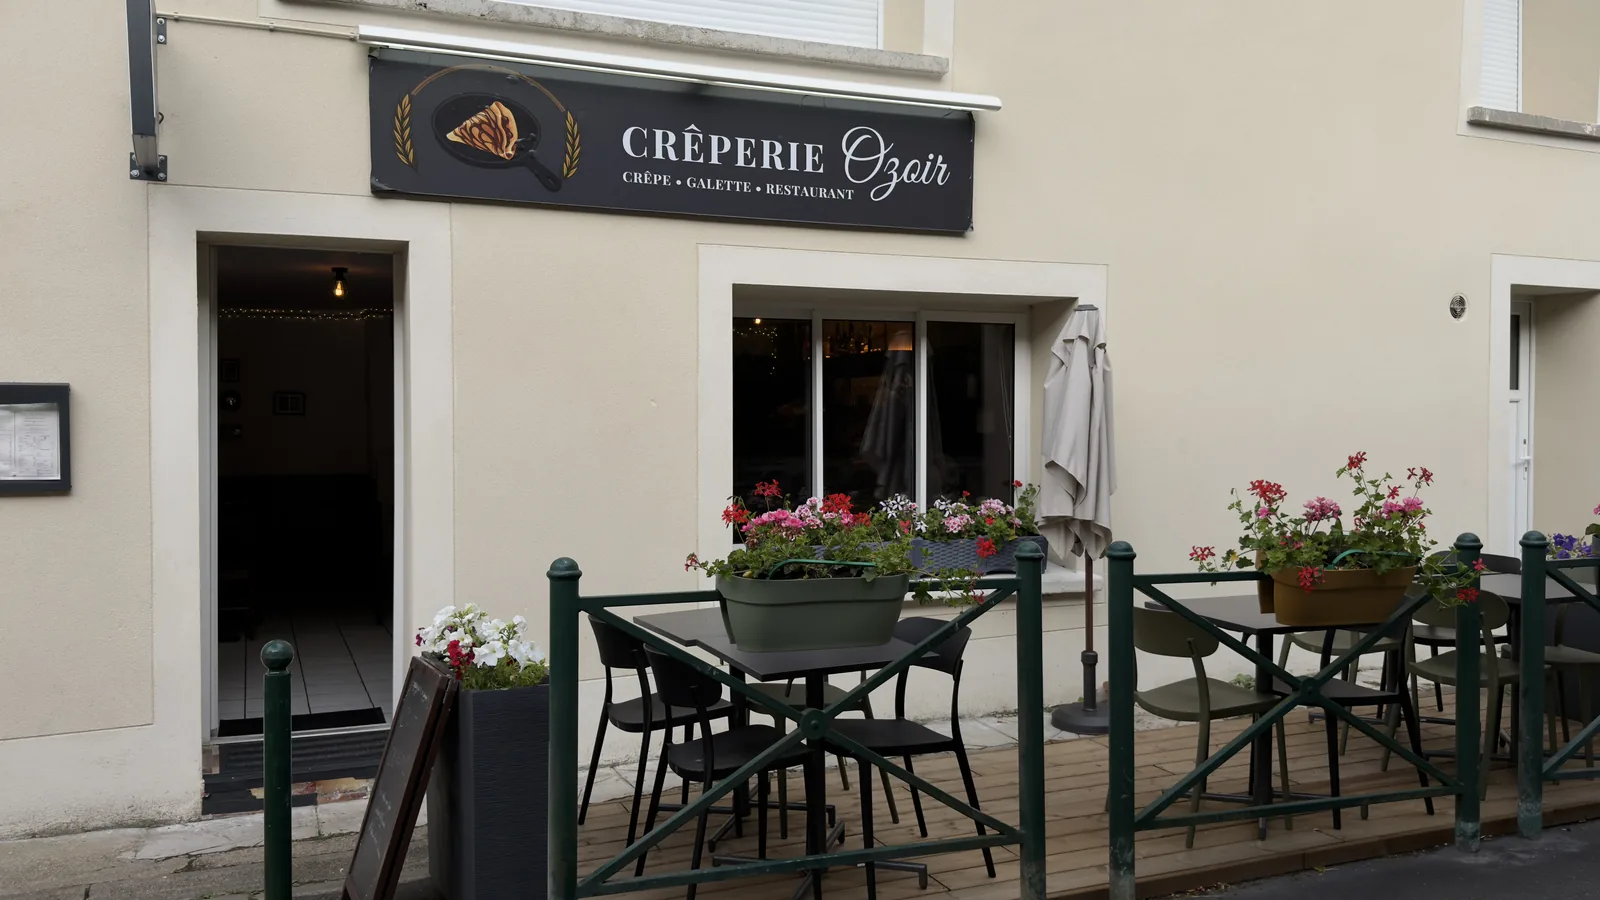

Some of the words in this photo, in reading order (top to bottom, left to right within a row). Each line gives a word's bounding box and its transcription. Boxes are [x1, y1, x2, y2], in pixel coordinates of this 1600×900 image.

[622, 124, 824, 174] CRÊPERIE
[841, 126, 951, 202] Ozoir
[622, 170, 672, 187] CRÊPE
[686, 177, 752, 193] GALETTE
[766, 183, 855, 200] RESTAURANT
